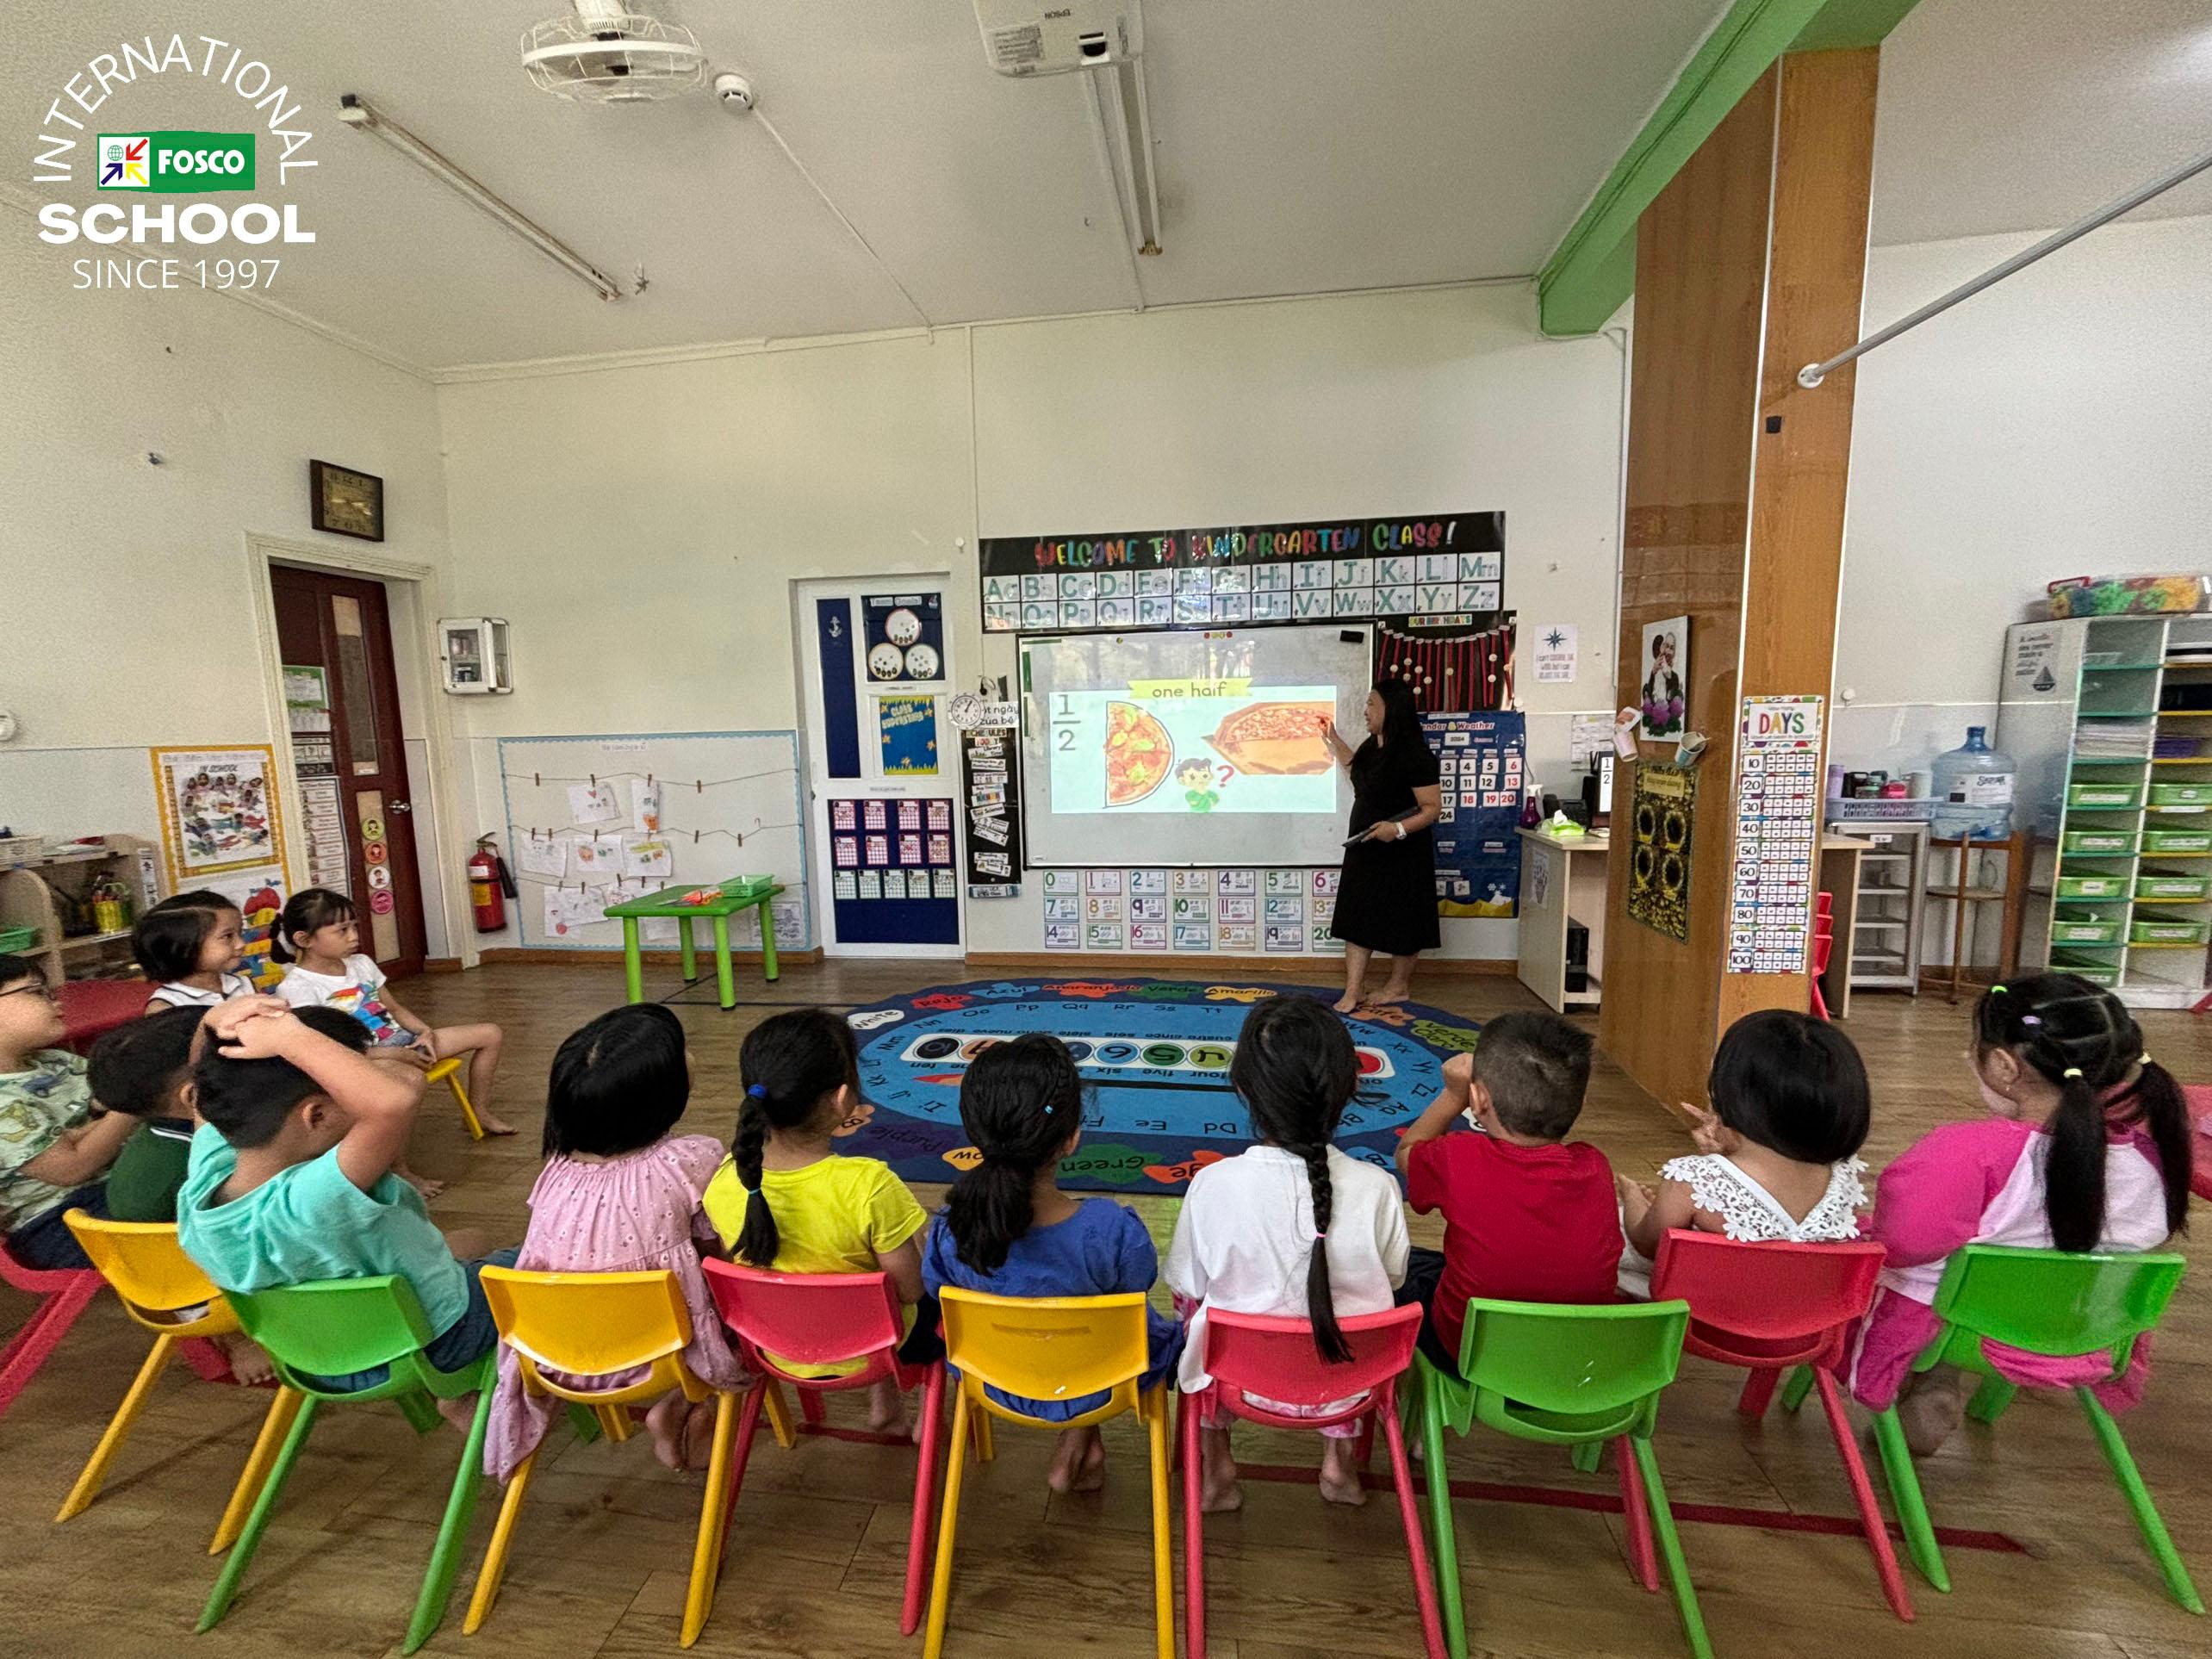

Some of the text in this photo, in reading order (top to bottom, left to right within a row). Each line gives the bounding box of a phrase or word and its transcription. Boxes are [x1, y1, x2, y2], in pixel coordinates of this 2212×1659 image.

[1034, 538, 1139, 567] WELCOME
[1256, 566, 1288, 589] Hh
[1338, 561, 1367, 585] Jj
[1380, 558, 1408, 583] Kk
[1296, 592, 1329, 616] Vv
[1335, 592, 1372, 612] Ww
[1377, 588, 1413, 613] Xx
[1421, 587, 1451, 610] Yy
[1463, 585, 1495, 609] Zz
[1152, 680, 1227, 699] one half
[1057, 694, 1076, 716] 1
[1457, 721, 1495, 730] Weather
[1759, 712, 1805, 735] DAYS
[1058, 729, 1077, 751] 2
[1605, 758, 1610, 768] 1
[1748, 758, 1760, 769] 10
[1216, 764, 1235, 788] ?
[1482, 778, 1492, 786] 12
[1603, 774, 1610, 785] 2
[1744, 780, 1761, 791] 20
[1443, 796, 1453, 805] 17
[1743, 802, 1759, 813] 30
[1440, 811, 1452, 820] 24
[1742, 823, 1758, 834] 40
[1741, 846, 1757, 856] 50
[1739, 867, 1755, 877] 60
[1046, 873, 1326, 888] 0 1 2 3 4 5 6
[1738, 888, 1755, 899] 70
[1046, 898, 1326, 914] 7 8 9 10 11 12 13
[1737, 910, 1753, 920] 80
[1046, 925, 1333, 941] 14 15 16 17 18 19 20
[1736, 934, 1751, 944] 90
[1732, 954, 1751, 966] 100
[854, 1010, 898, 1029] White
[1104, 1046, 1132, 1059] 6
[1148, 1046, 1177, 1061] 5
[1197, 1049, 1226, 1063] 4
[1142, 1068, 1175, 1077] five
[869, 1126, 944, 1152] Purple
[1060, 1155, 1146, 1172] Green
